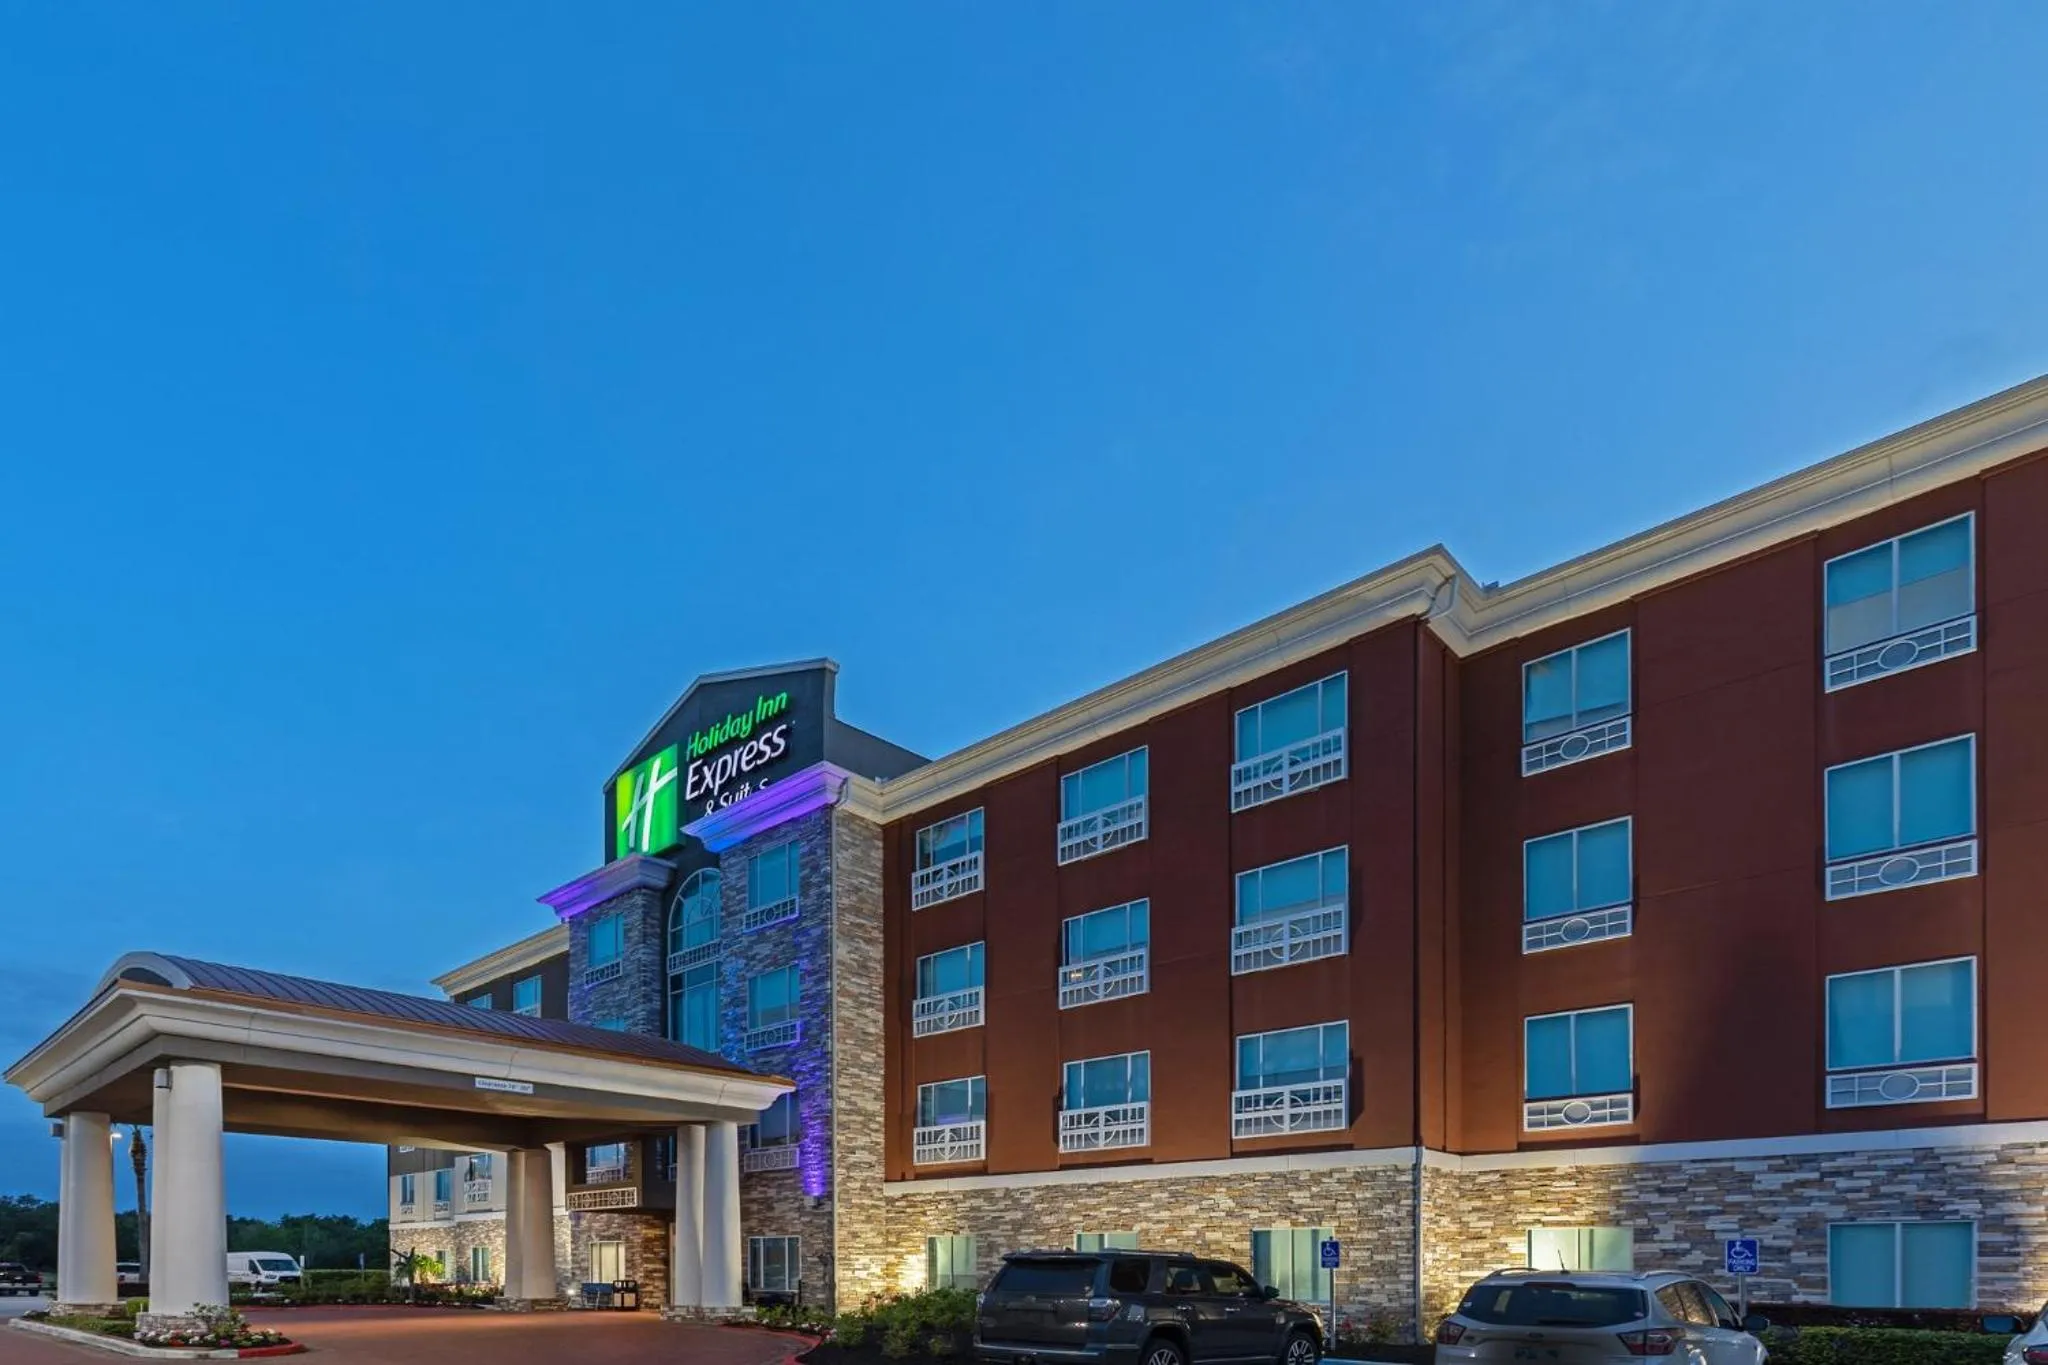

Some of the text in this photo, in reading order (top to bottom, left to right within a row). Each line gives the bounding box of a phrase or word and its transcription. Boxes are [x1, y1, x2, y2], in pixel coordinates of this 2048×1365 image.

[687, 691, 788, 762] Holiday Inn
[685, 724, 787, 801] Express
[719, 777, 769, 808] Suits
